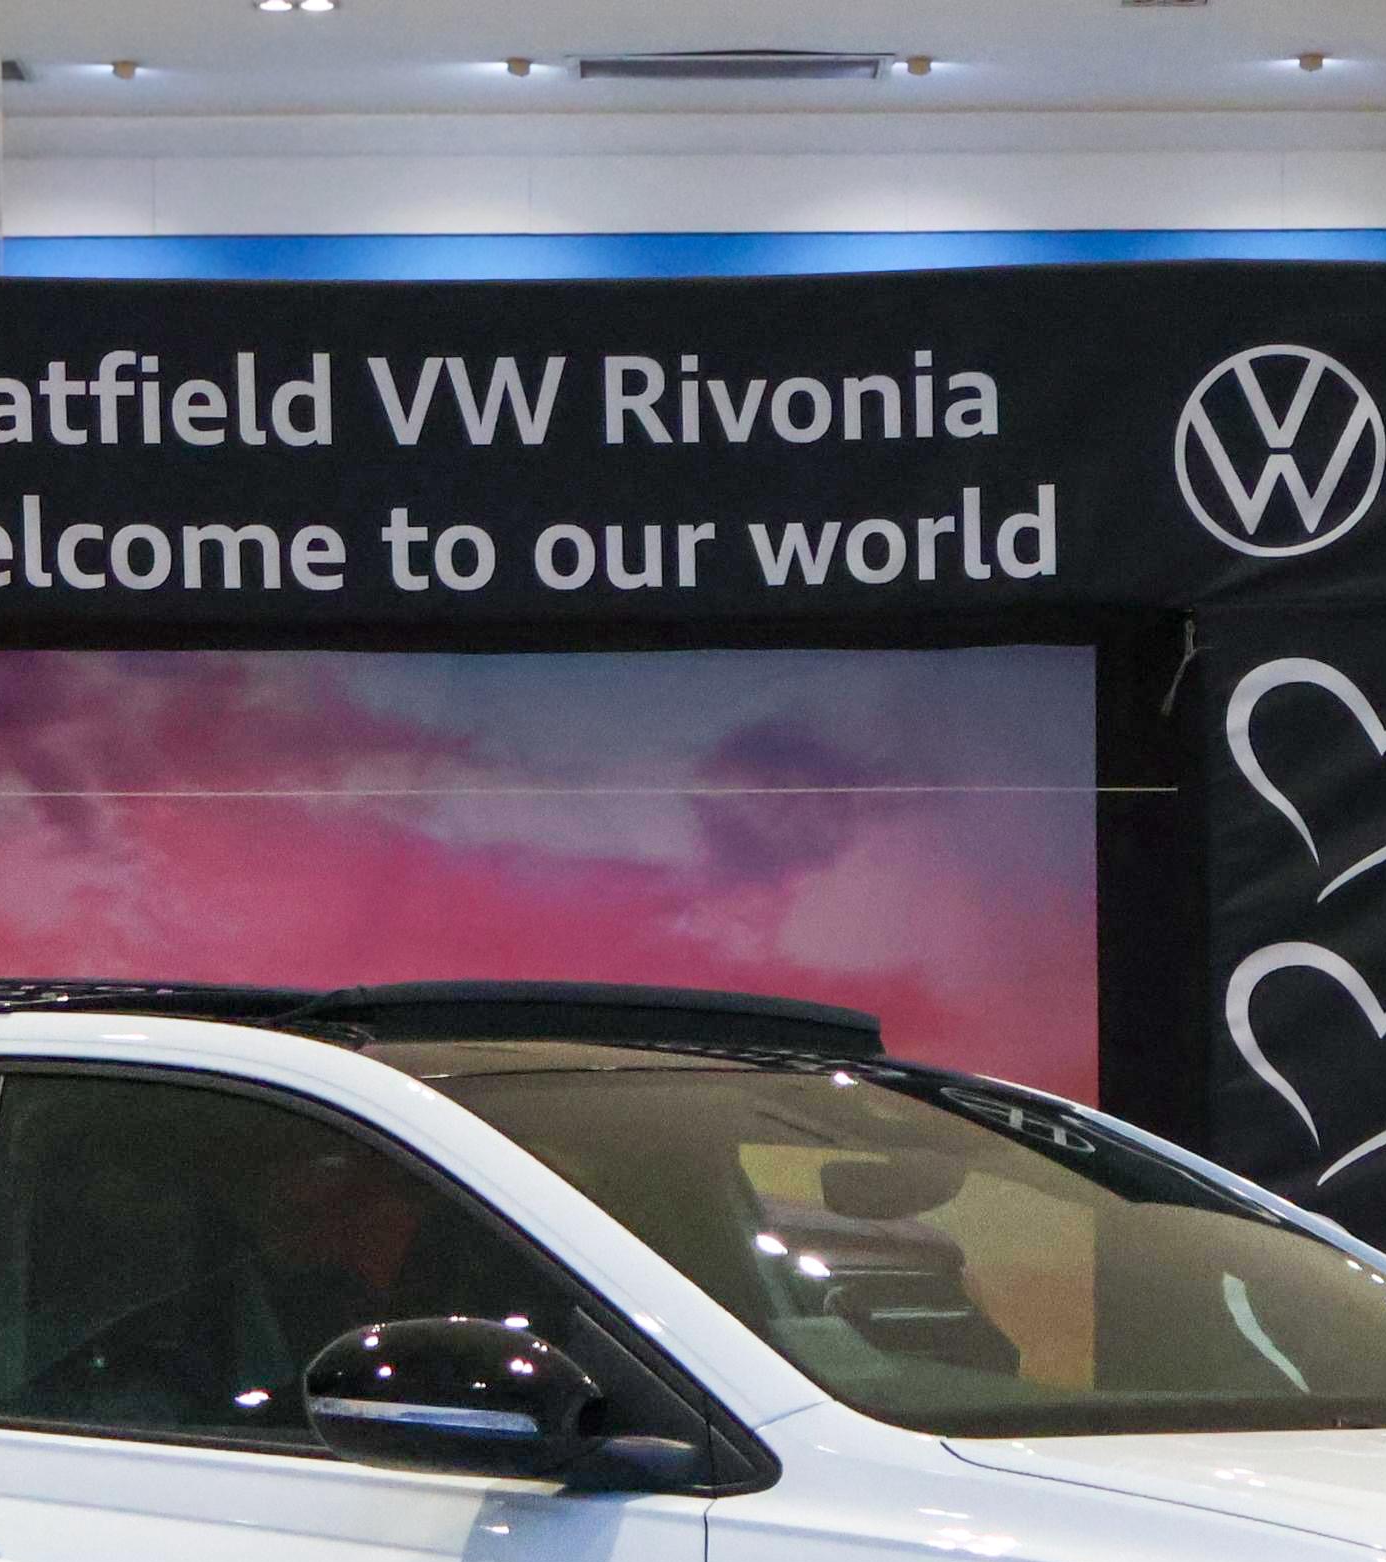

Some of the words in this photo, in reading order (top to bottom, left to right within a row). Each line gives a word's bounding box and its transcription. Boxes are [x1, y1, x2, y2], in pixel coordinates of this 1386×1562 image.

[367, 356, 566, 446] VW
[604, 350, 1000, 445] Rivonia
[1174, 344, 1386, 557] VW
[381, 507, 496, 592] to
[534, 522, 716, 591] our
[749, 483, 1057, 587] world
